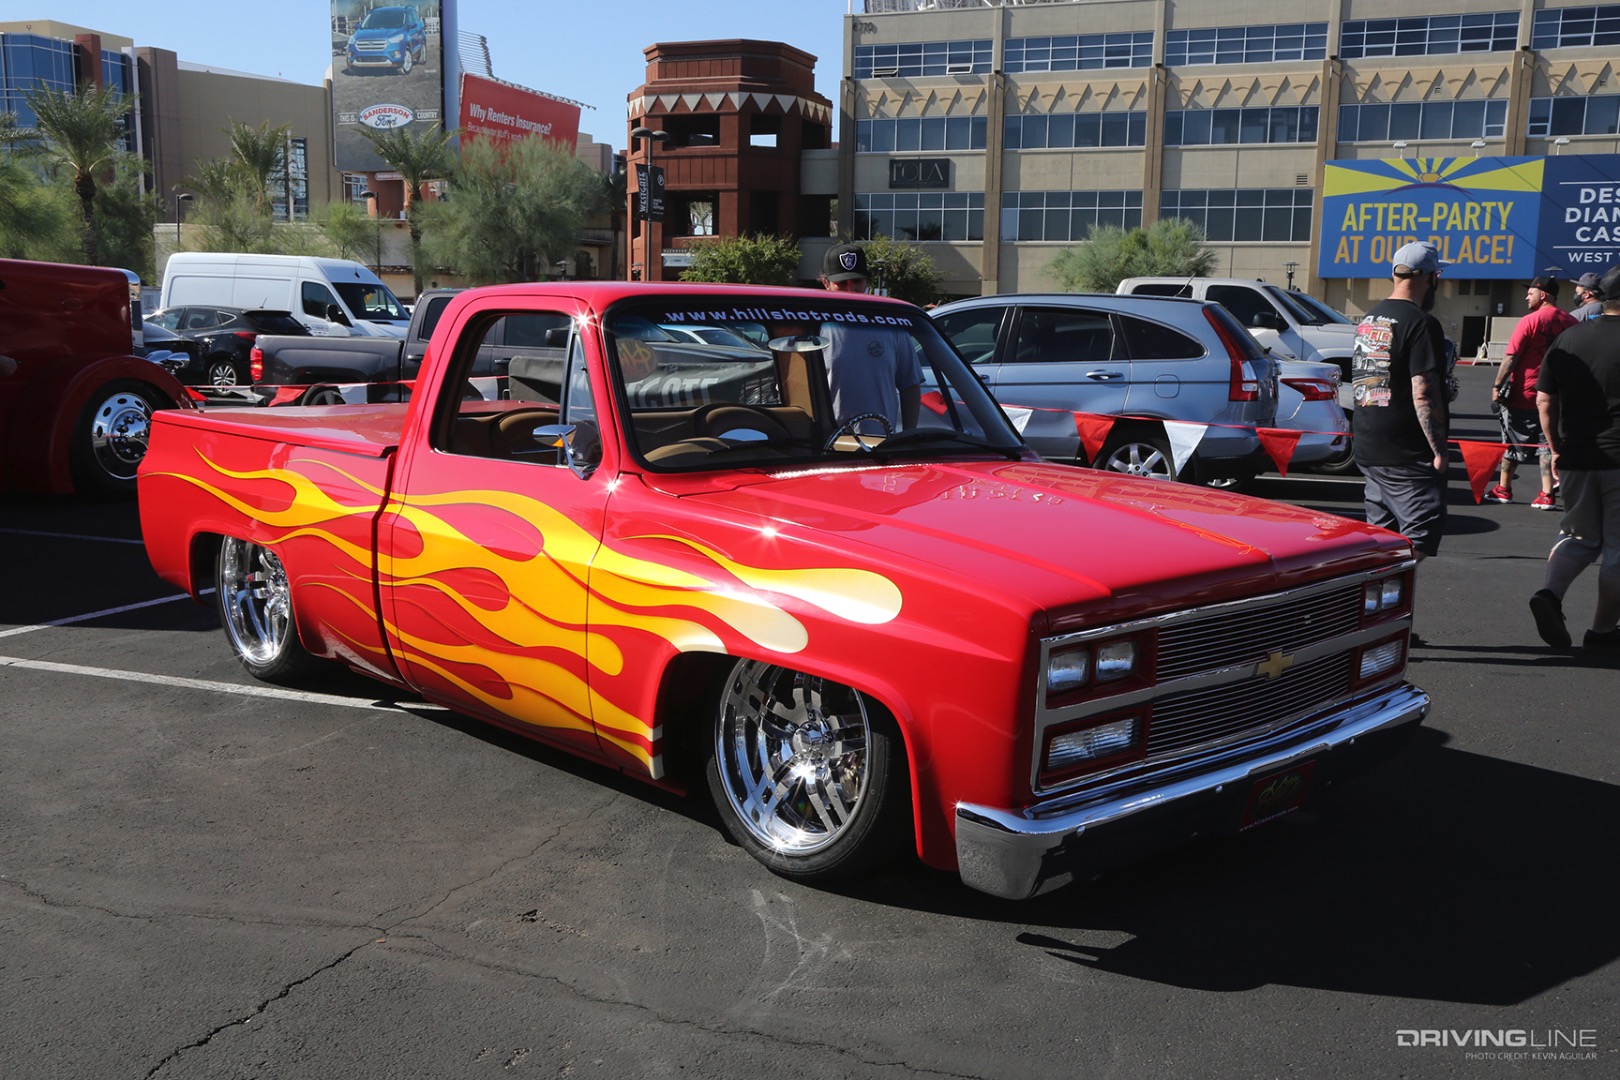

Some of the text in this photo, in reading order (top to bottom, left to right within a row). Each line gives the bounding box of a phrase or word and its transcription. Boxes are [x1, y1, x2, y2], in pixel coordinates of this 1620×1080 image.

[362, 107, 410, 121] SANDERSON
[375, 114, 398, 127] Ford
[416, 111, 438, 120] COUNTRY
[469, 102, 552, 135] Why Renters Insurance?
[1340, 201, 1514, 232] AFTER-PARTY
[1334, 235, 1364, 264] AT
[1568, 252, 1613, 263] WEST
[666, 308, 913, 327] www.hillshotrods.com
